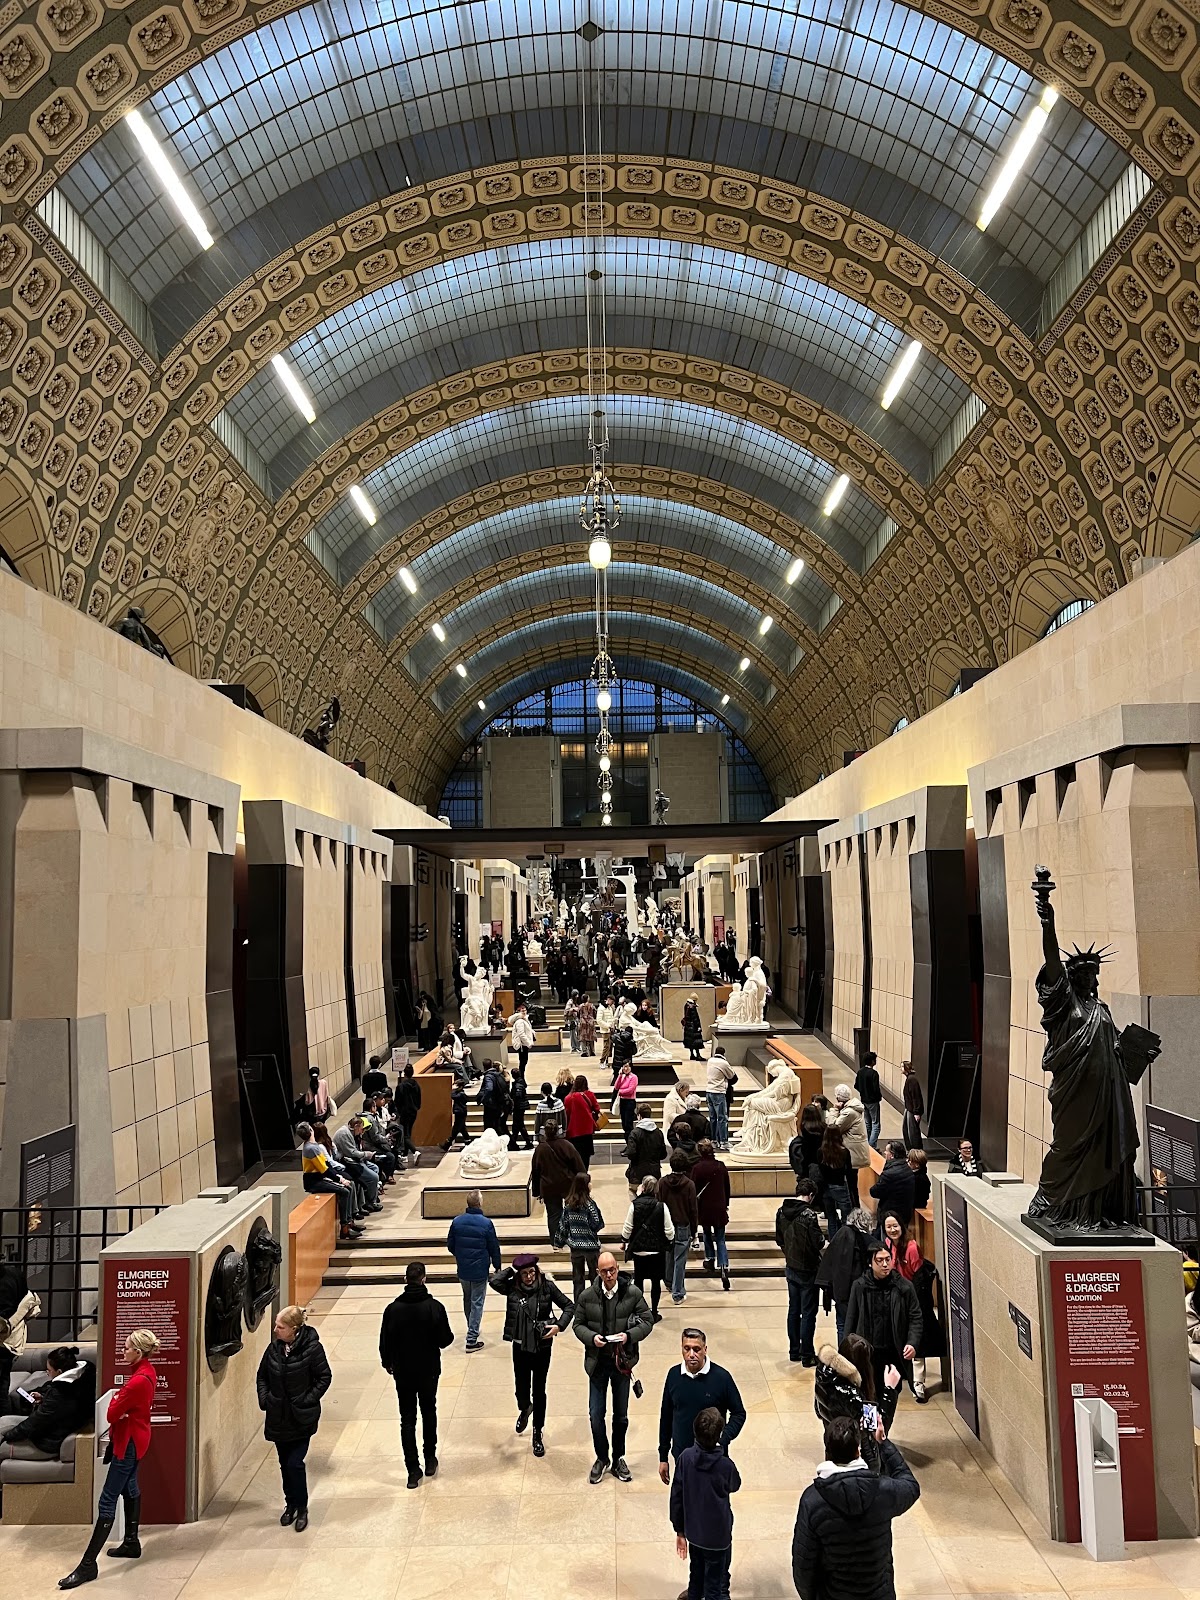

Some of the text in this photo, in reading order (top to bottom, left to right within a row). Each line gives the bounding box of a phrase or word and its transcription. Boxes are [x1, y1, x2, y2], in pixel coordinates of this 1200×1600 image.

[118, 1270, 169, 1280] ELMGREEN
[1065, 1273, 1120, 1282] ELMGREEN
[118, 1280, 168, 1290] & DRAGSET
[1066, 1284, 1120, 1292] & DRAGSET
